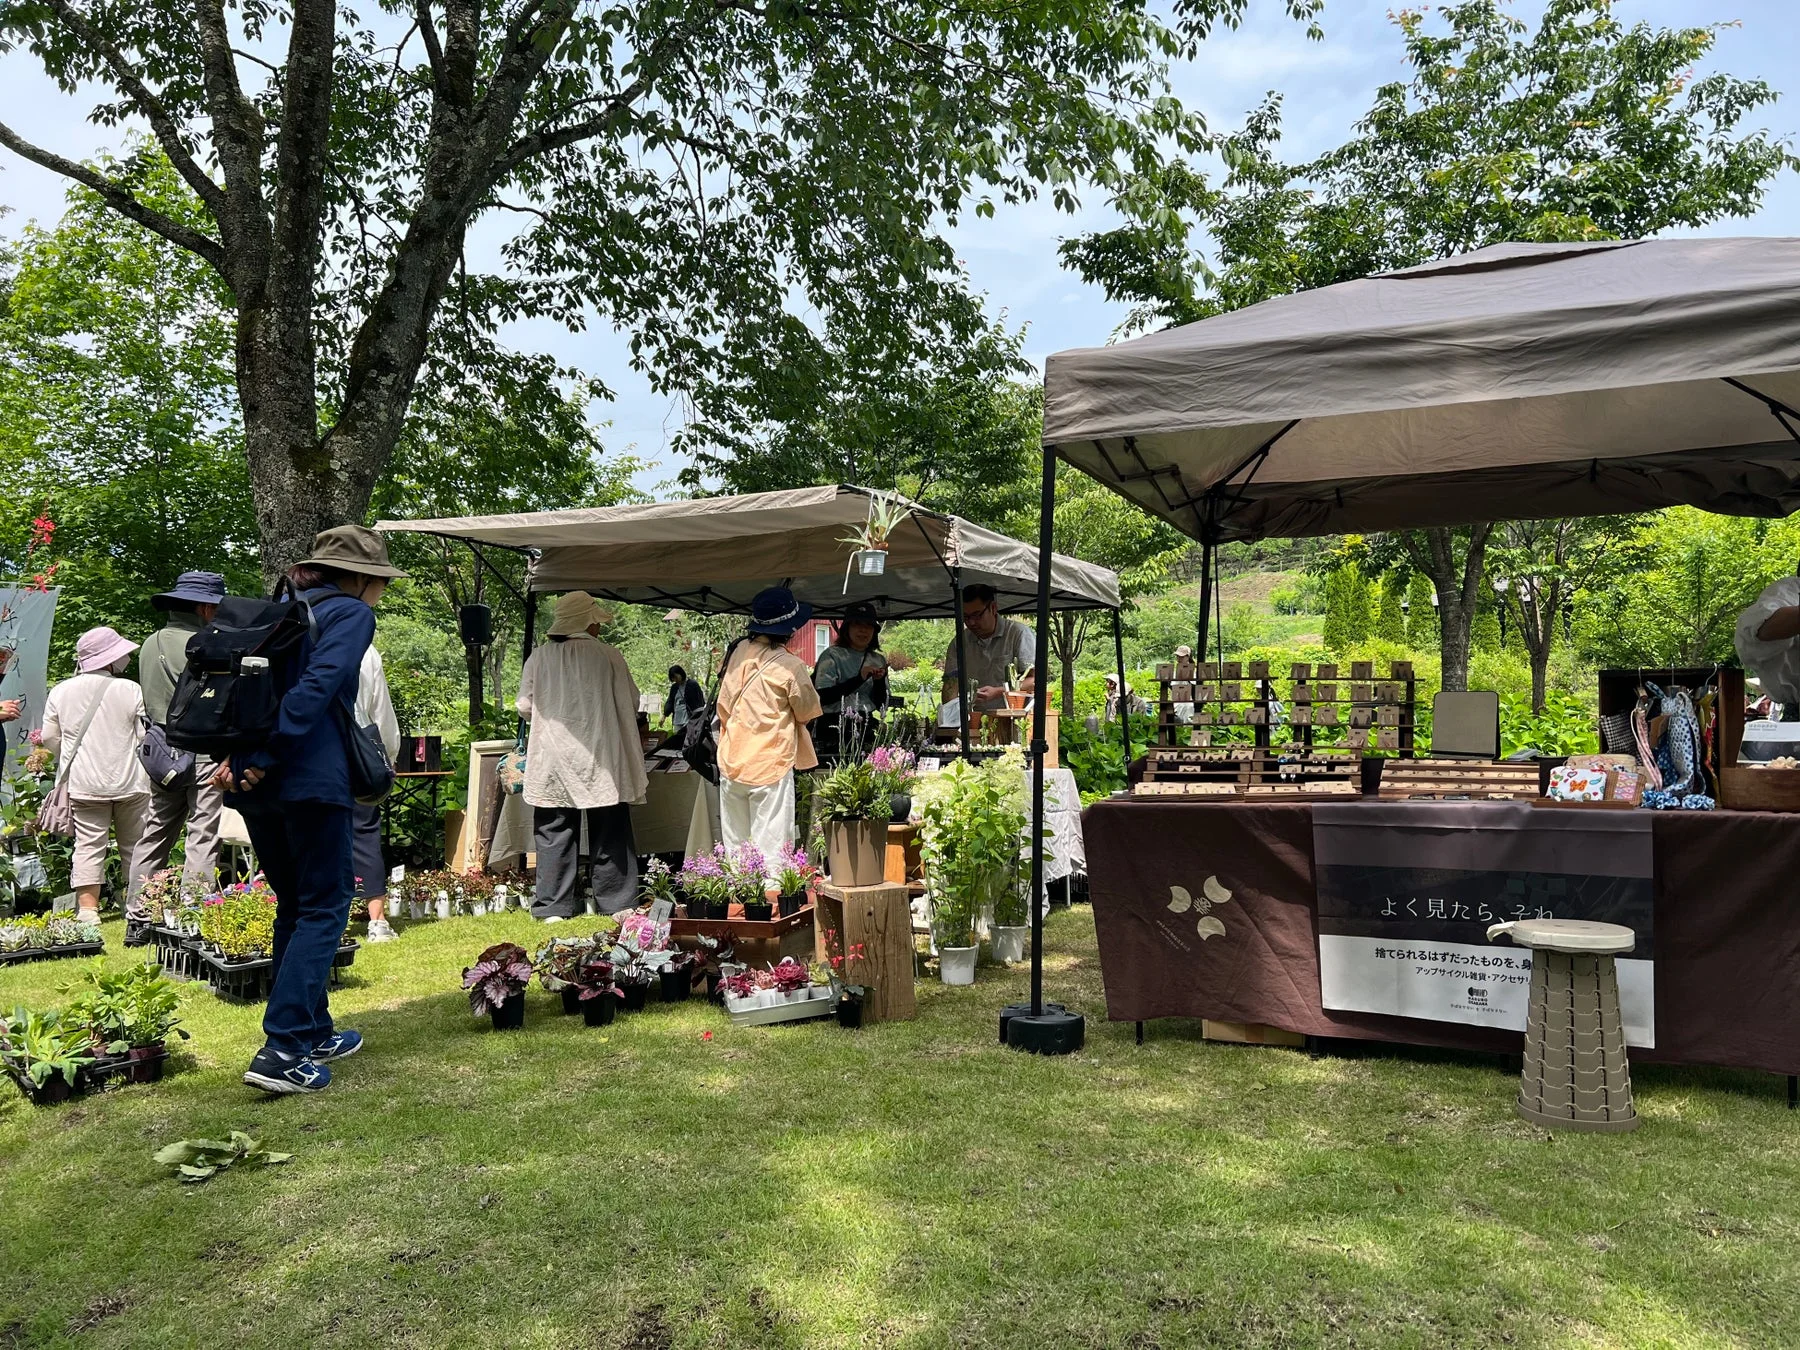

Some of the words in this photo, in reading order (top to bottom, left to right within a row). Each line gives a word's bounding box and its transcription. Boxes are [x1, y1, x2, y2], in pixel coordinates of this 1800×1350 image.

[1375, 947, 1532, 971] 捨てられるはずだったものを、身
